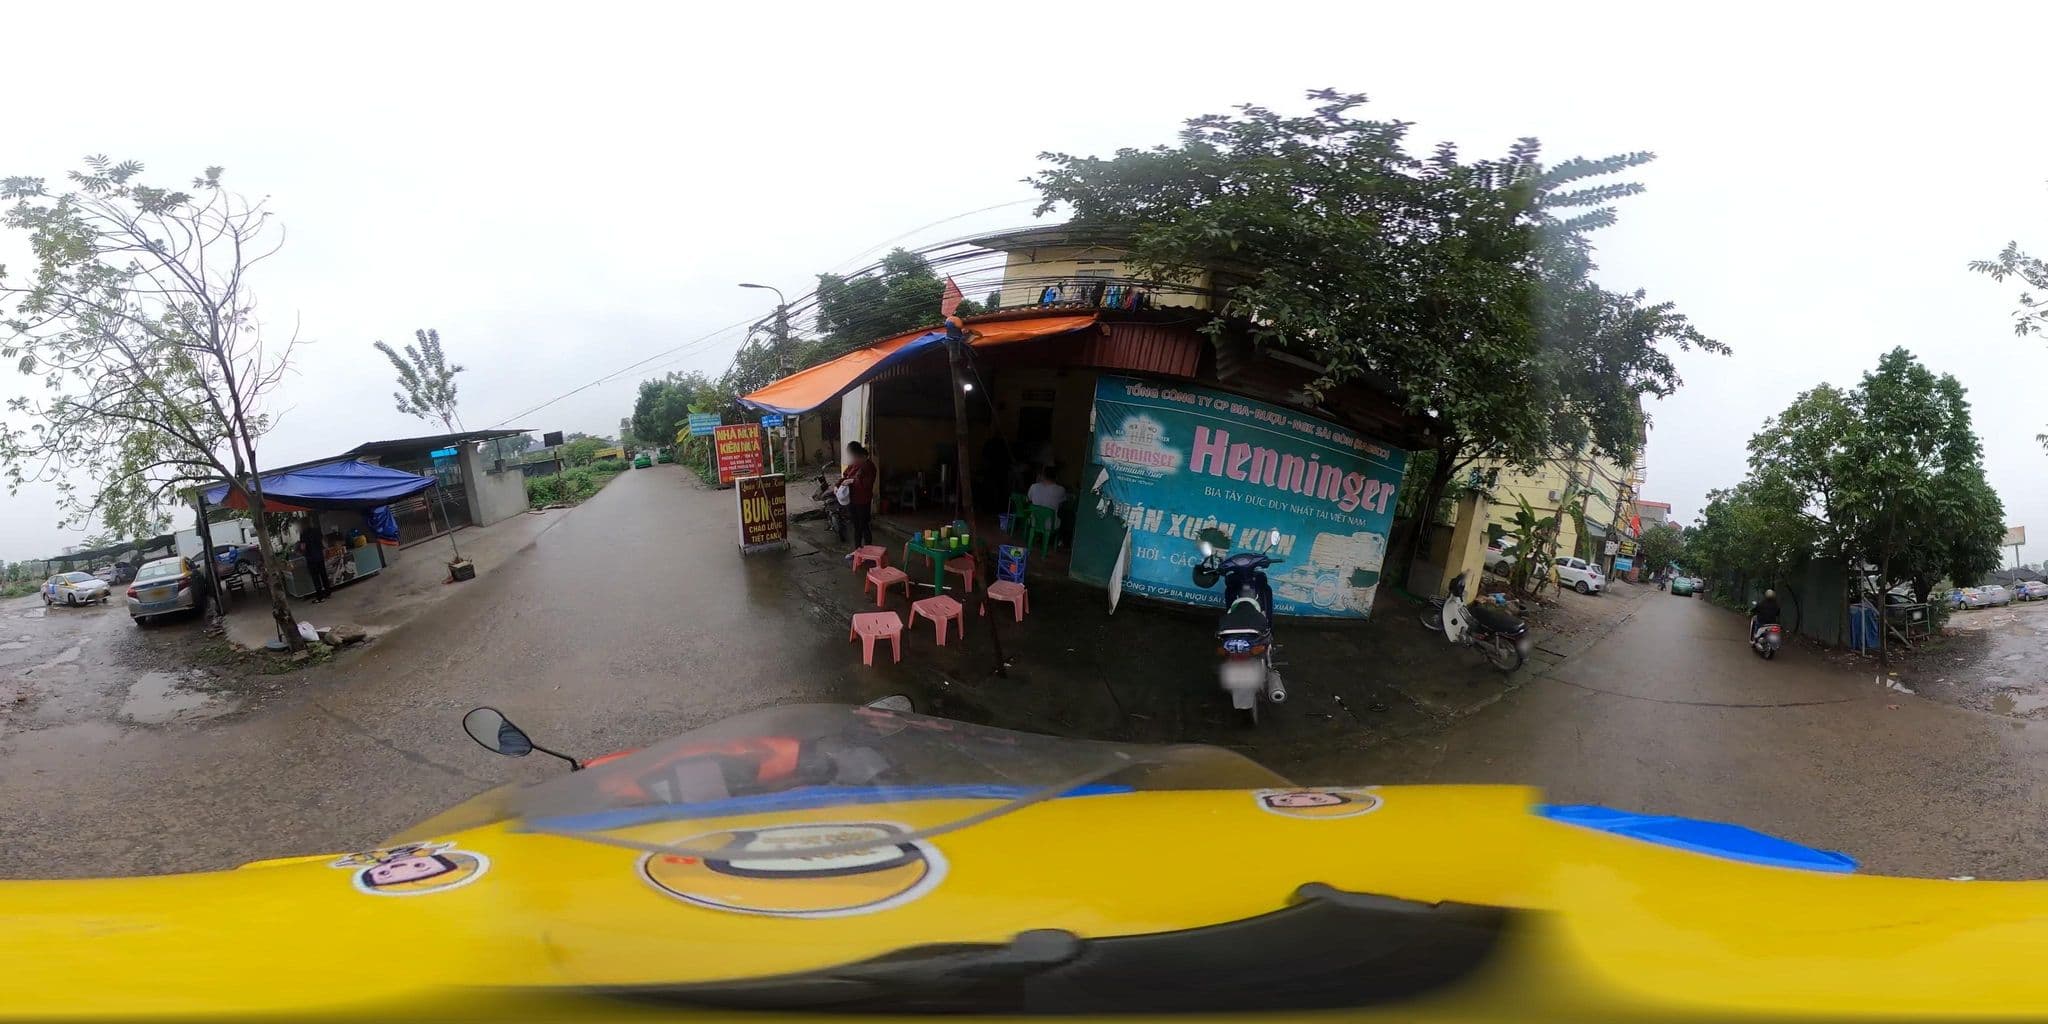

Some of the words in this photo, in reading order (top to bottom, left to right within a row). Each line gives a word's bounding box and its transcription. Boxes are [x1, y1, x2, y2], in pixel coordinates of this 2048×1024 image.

[1161, 388, 1195, 404] CÔNG
[1197, 395, 1213, 407] TY
[1214, 399, 1229, 410] CP
[1189, 426, 1395, 514] Henninger
[1204, 486, 1221, 498] BIA
[743, 490, 769, 524] BÚN
[1126, 580, 1146, 592] ÔNG
